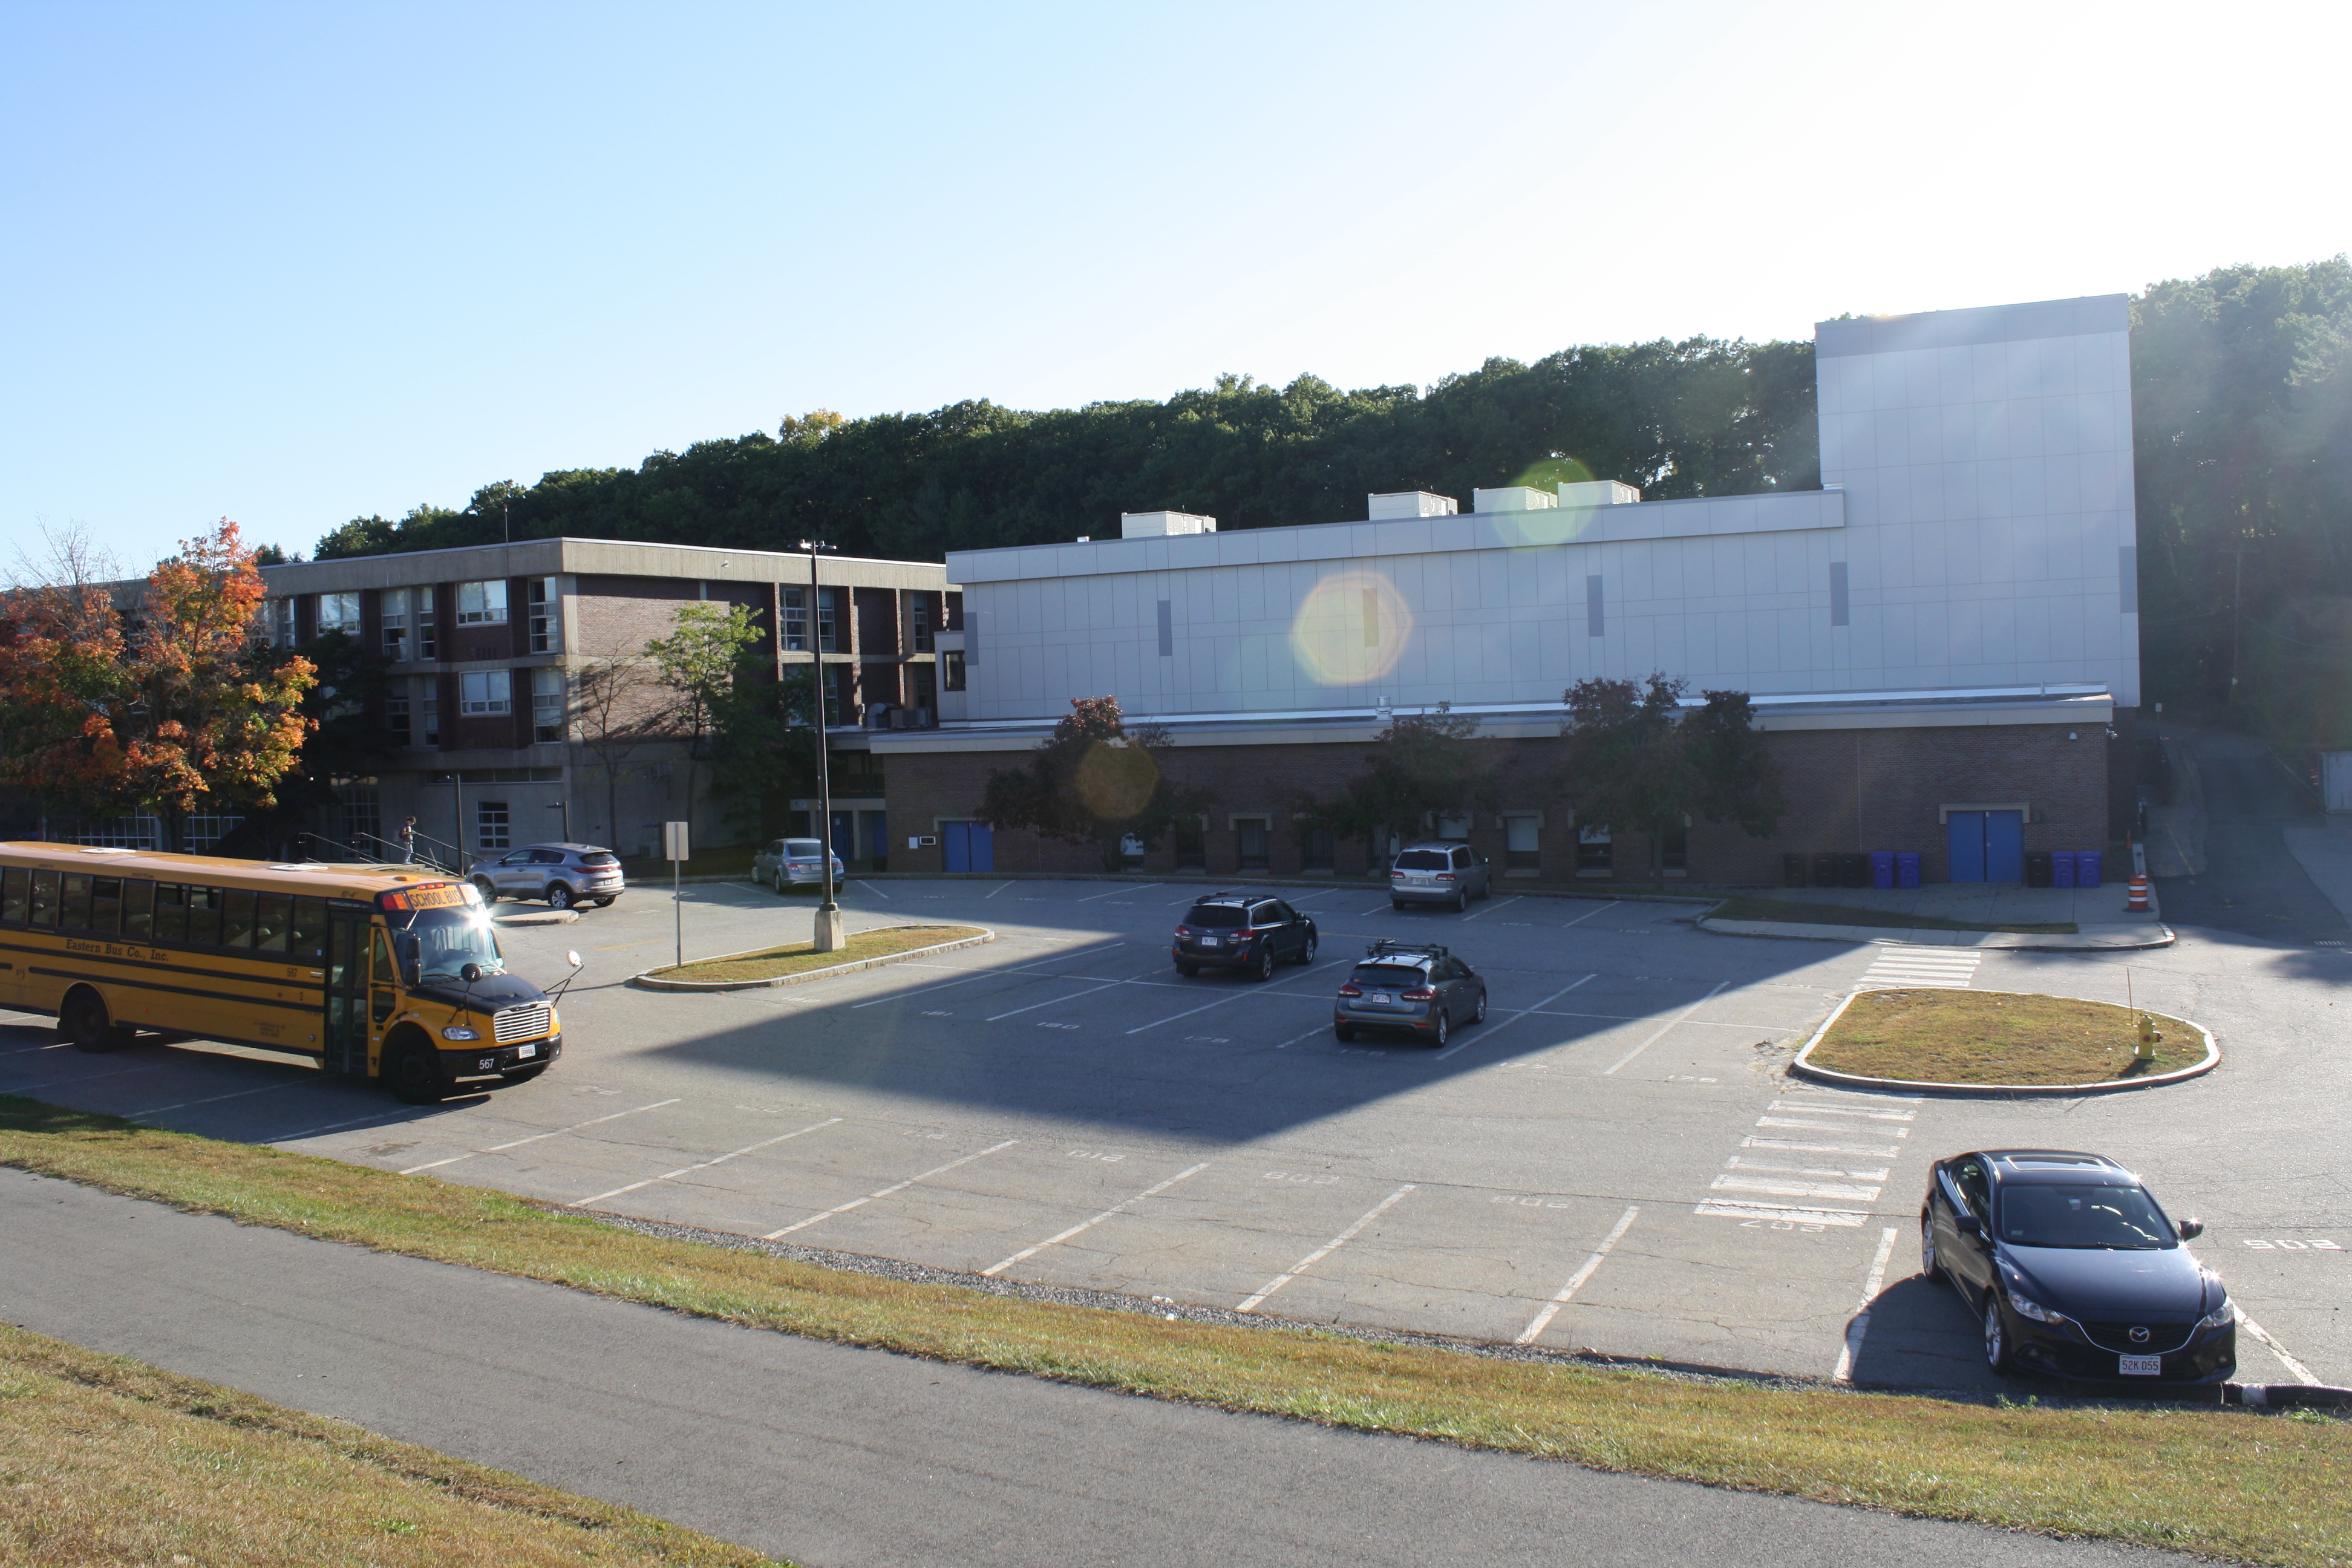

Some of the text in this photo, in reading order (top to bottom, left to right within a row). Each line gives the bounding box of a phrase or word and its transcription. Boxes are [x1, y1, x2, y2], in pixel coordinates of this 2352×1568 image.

[410, 889, 463, 907] SCHOOL BUS
[66, 939, 169, 961] Eastern Bus Co., Inc.
[287, 967, 298, 978] 567
[299, 991, 304, 1001] 2
[479, 1058, 494, 1070] 567
[2122, 1360, 2158, 1371] 52K D55
